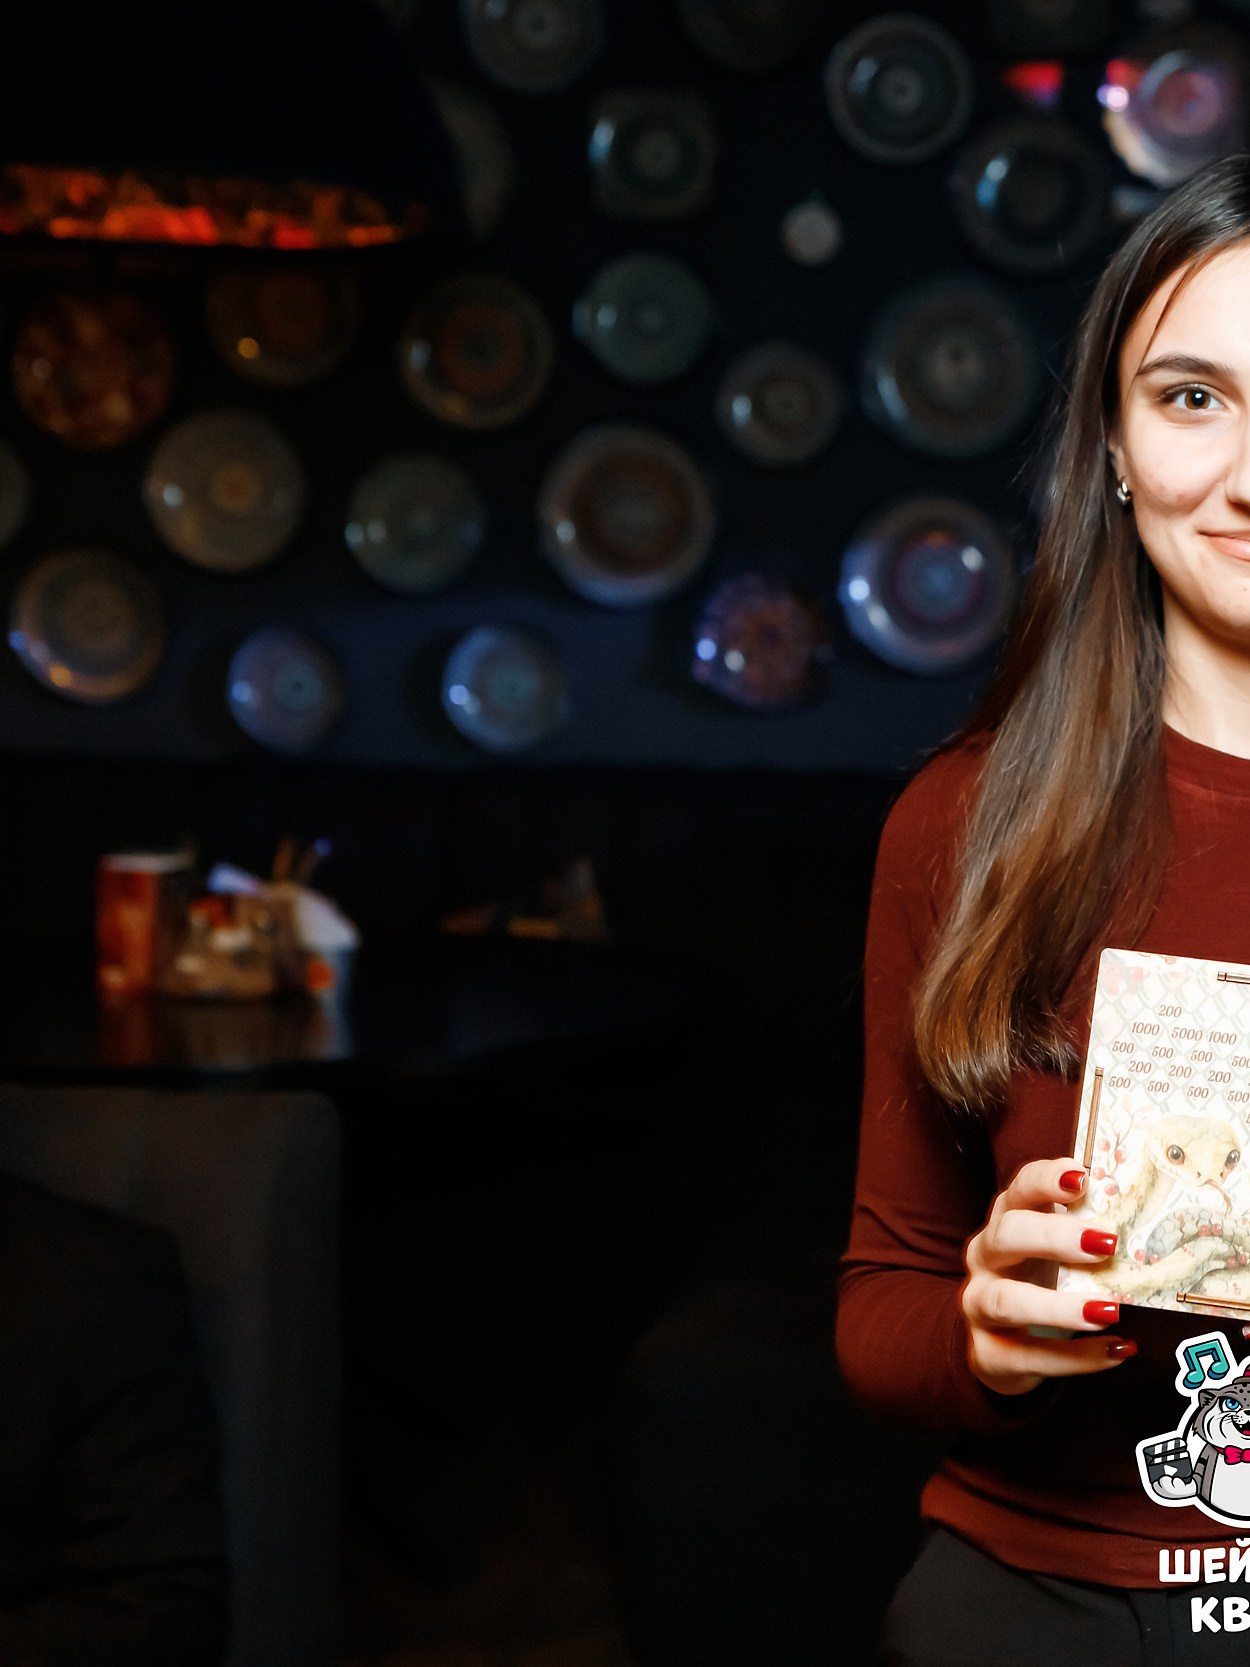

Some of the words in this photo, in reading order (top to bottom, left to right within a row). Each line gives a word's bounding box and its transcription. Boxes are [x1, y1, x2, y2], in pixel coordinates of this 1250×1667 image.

[1158, 1005, 1182, 1018] 200
[1132, 1022, 1160, 1035] 1000
[1171, 1027, 1203, 1041] 5000
[1208, 1031, 1237, 1045] 1000
[1112, 1041, 1134, 1053] 500
[1152, 1046, 1173, 1058] 500
[1190, 1050, 1212, 1062] 500
[1128, 1060, 1152, 1073] 200
[1168, 1065, 1192, 1078] 200
[1208, 1070, 1231, 1083] 200
[1109, 1076, 1131, 1088] 500
[1148, 1081, 1170, 1093] 500
[1187, 1086, 1209, 1098] 500
[1228, 1091, 1250, 1103] 500
